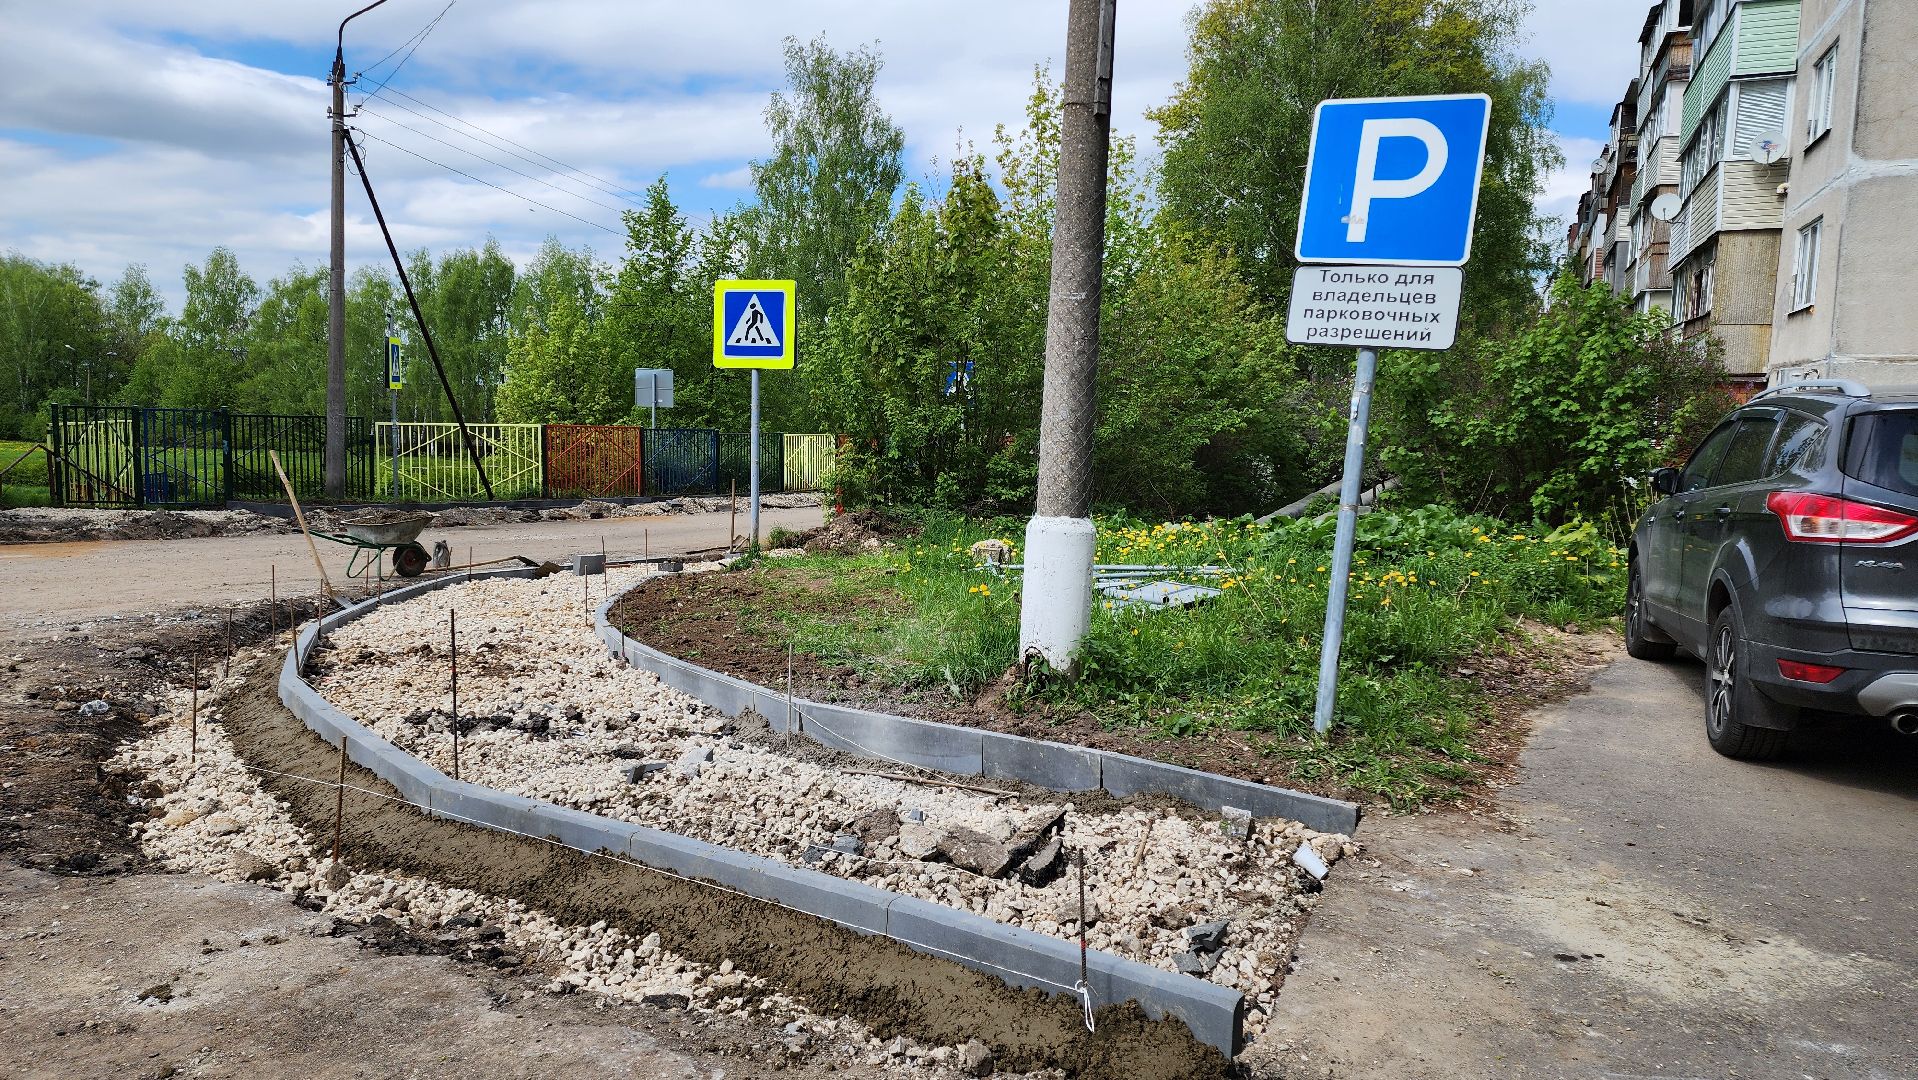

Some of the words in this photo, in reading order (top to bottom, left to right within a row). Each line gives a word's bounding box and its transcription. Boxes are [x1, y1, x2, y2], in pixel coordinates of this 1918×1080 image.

[1346, 117, 1449, 243] P
[1320, 269, 1389, 284] Только
[1395, 273, 1435, 287] для
[1312, 290, 1437, 305] владельцев
[1303, 308, 1441, 324] парковочных
[1306, 327, 1432, 342] разрешений
